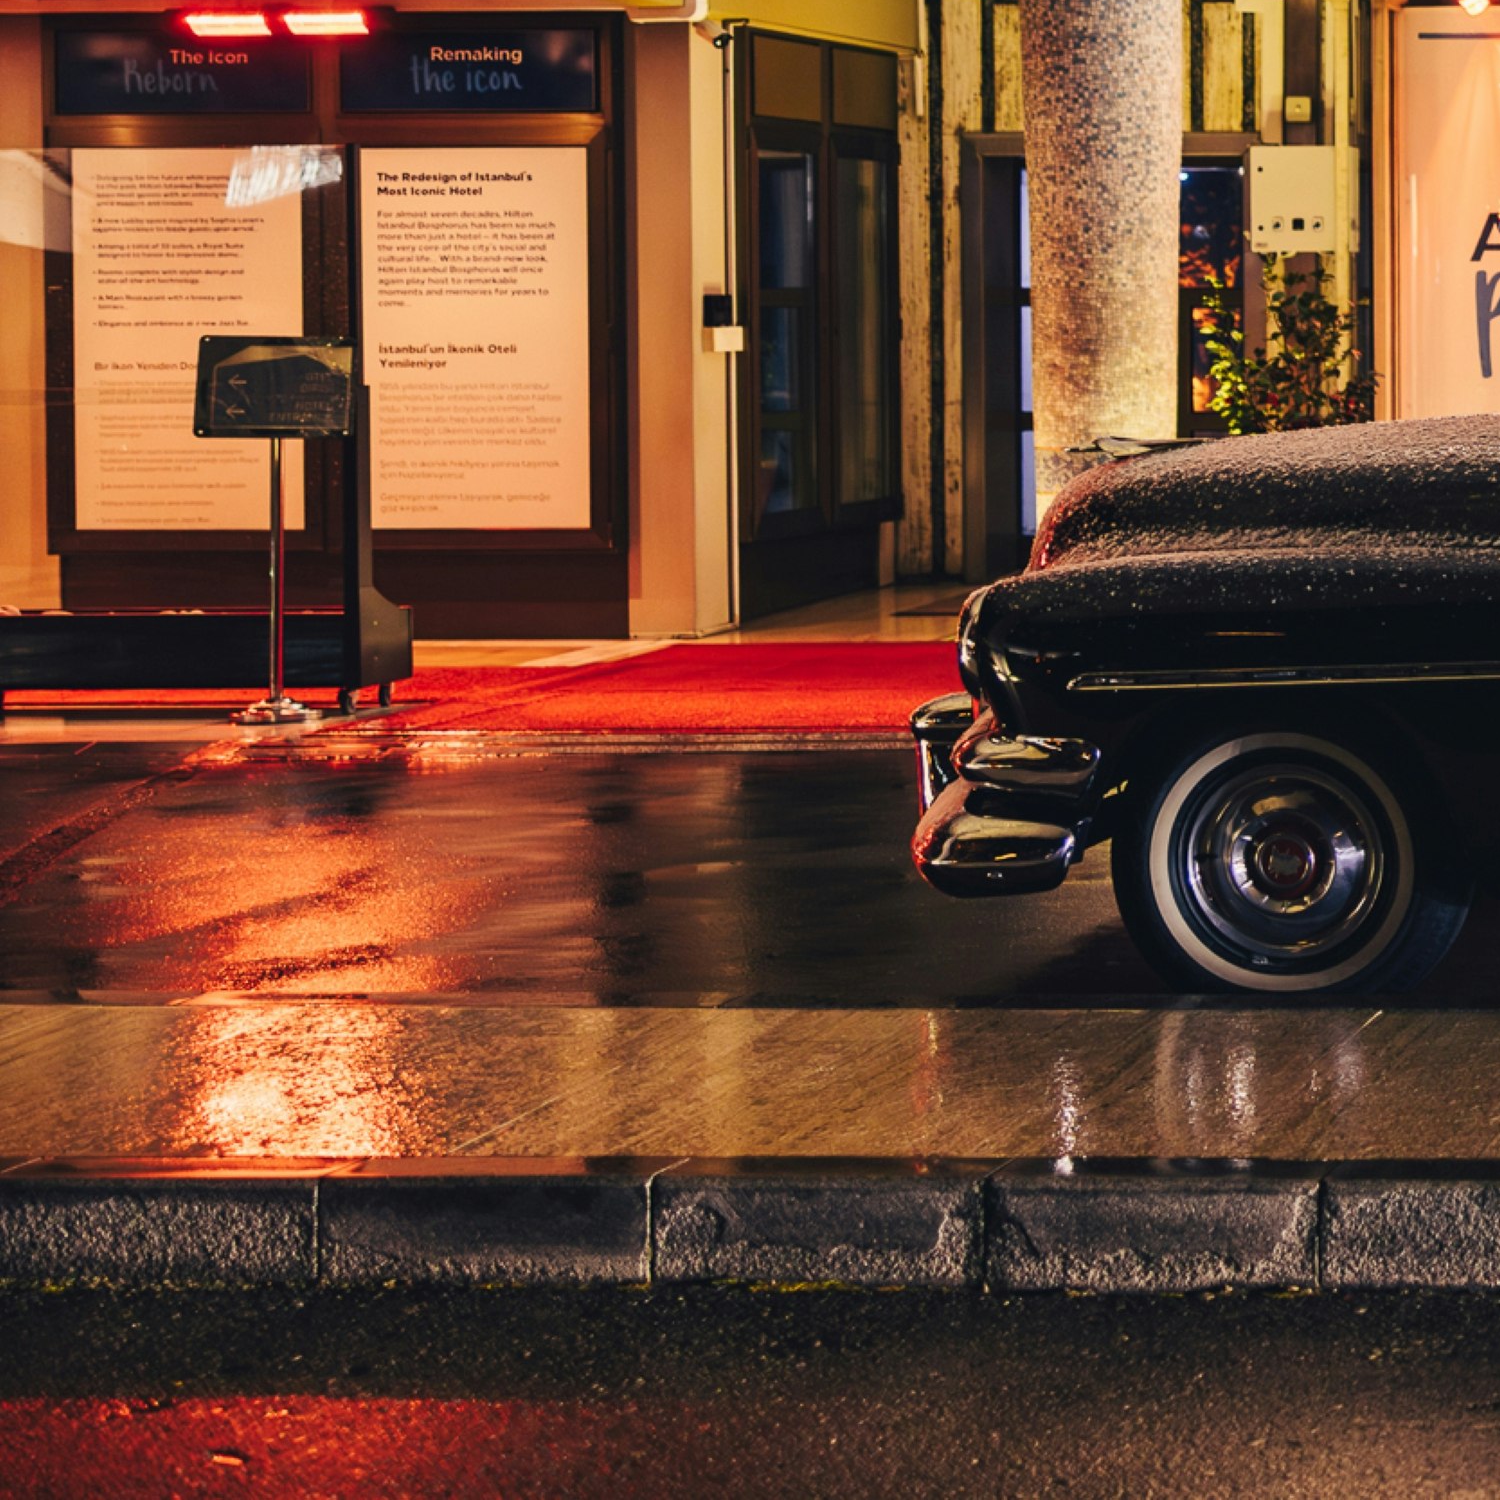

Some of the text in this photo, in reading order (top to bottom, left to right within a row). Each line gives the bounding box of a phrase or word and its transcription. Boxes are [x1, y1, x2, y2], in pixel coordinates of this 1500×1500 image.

[169, 49, 249, 65] The Icon
[430, 46, 523, 68] Remaking
[123, 58, 219, 94] Reborn
[409, 55, 523, 94] the icon
[377, 171, 399, 183] The
[402, 171, 457, 183] Redesign
[460, 171, 473, 183] of
[377, 186, 483, 197] Most Iconic Hotel
[487, 342, 517, 354] Oteli
[379, 359, 447, 370] Yenileniyor
